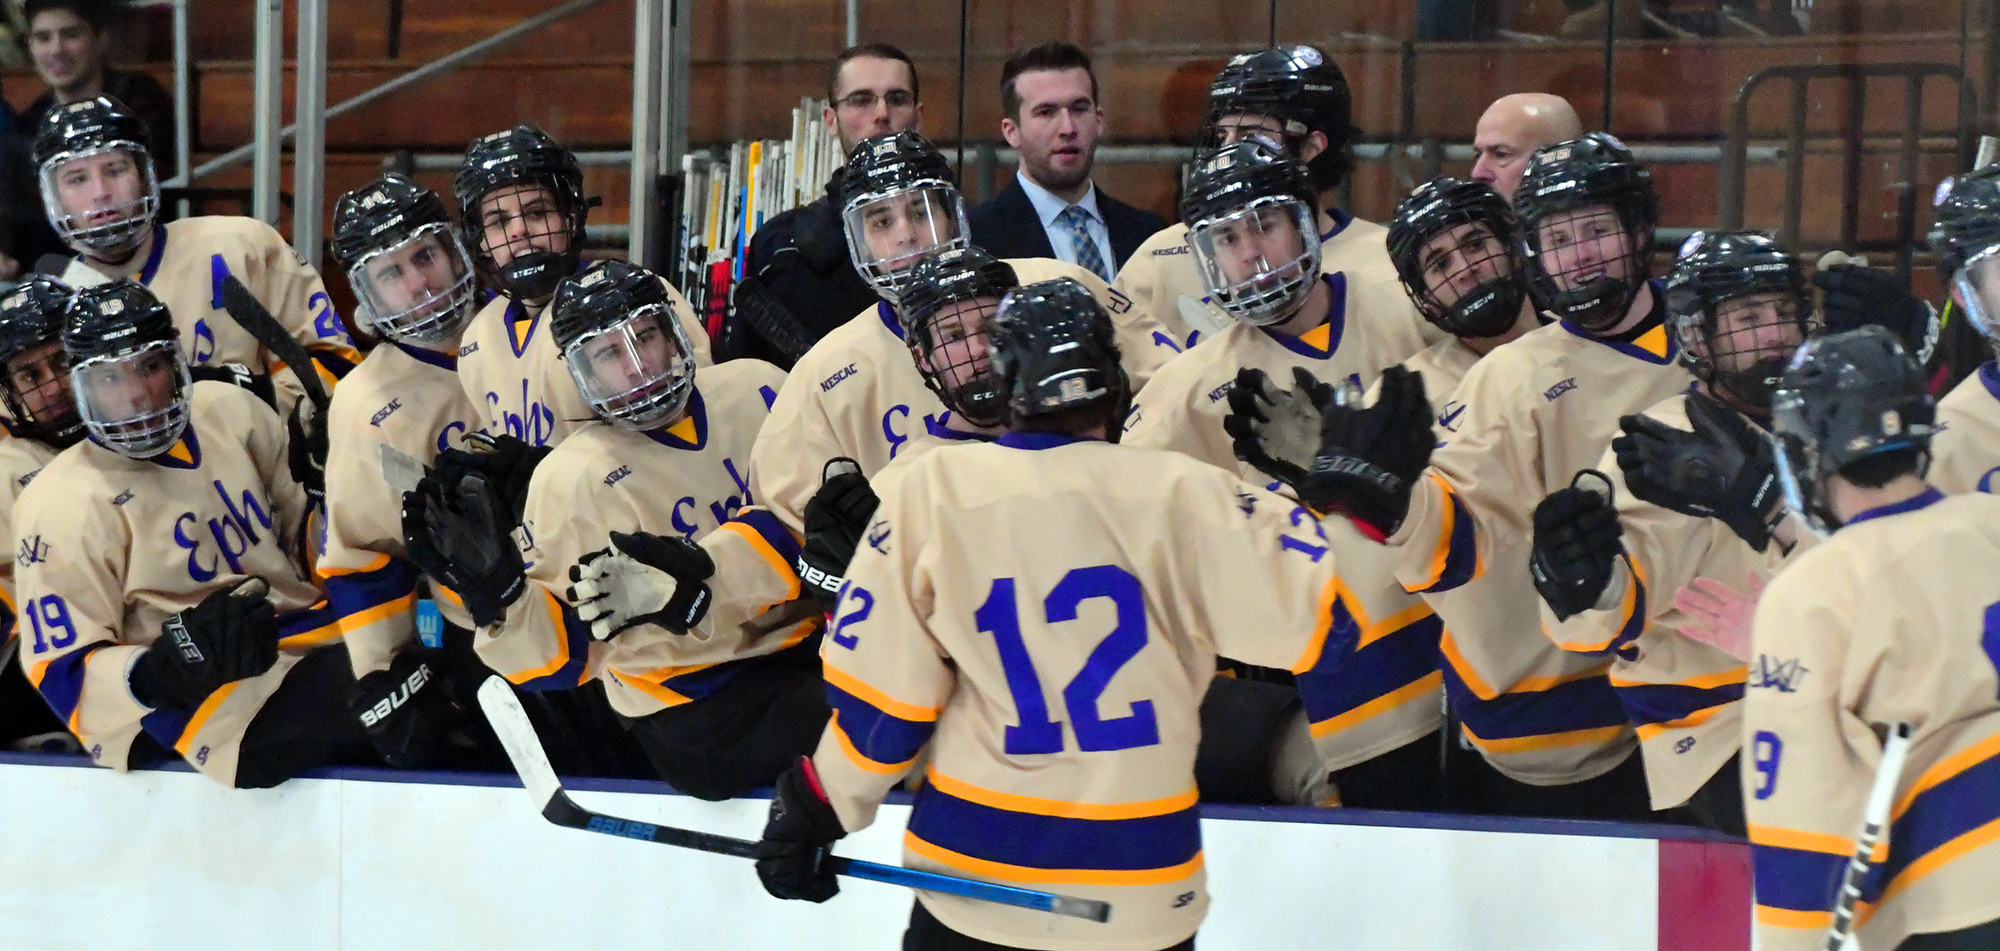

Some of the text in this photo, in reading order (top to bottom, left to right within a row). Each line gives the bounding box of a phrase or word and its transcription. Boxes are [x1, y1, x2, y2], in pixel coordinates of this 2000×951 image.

[370, 214, 404, 236] BAUER
[820, 362, 858, 393] NESCAC
[1208, 377, 1238, 404] NESC
[370, 397, 403, 427] NESCAC
[25, 593, 77, 654] 19
[976, 566, 1159, 754] 12
[359, 662, 433, 728] BAUER
[1754, 730, 1782, 800] 9
